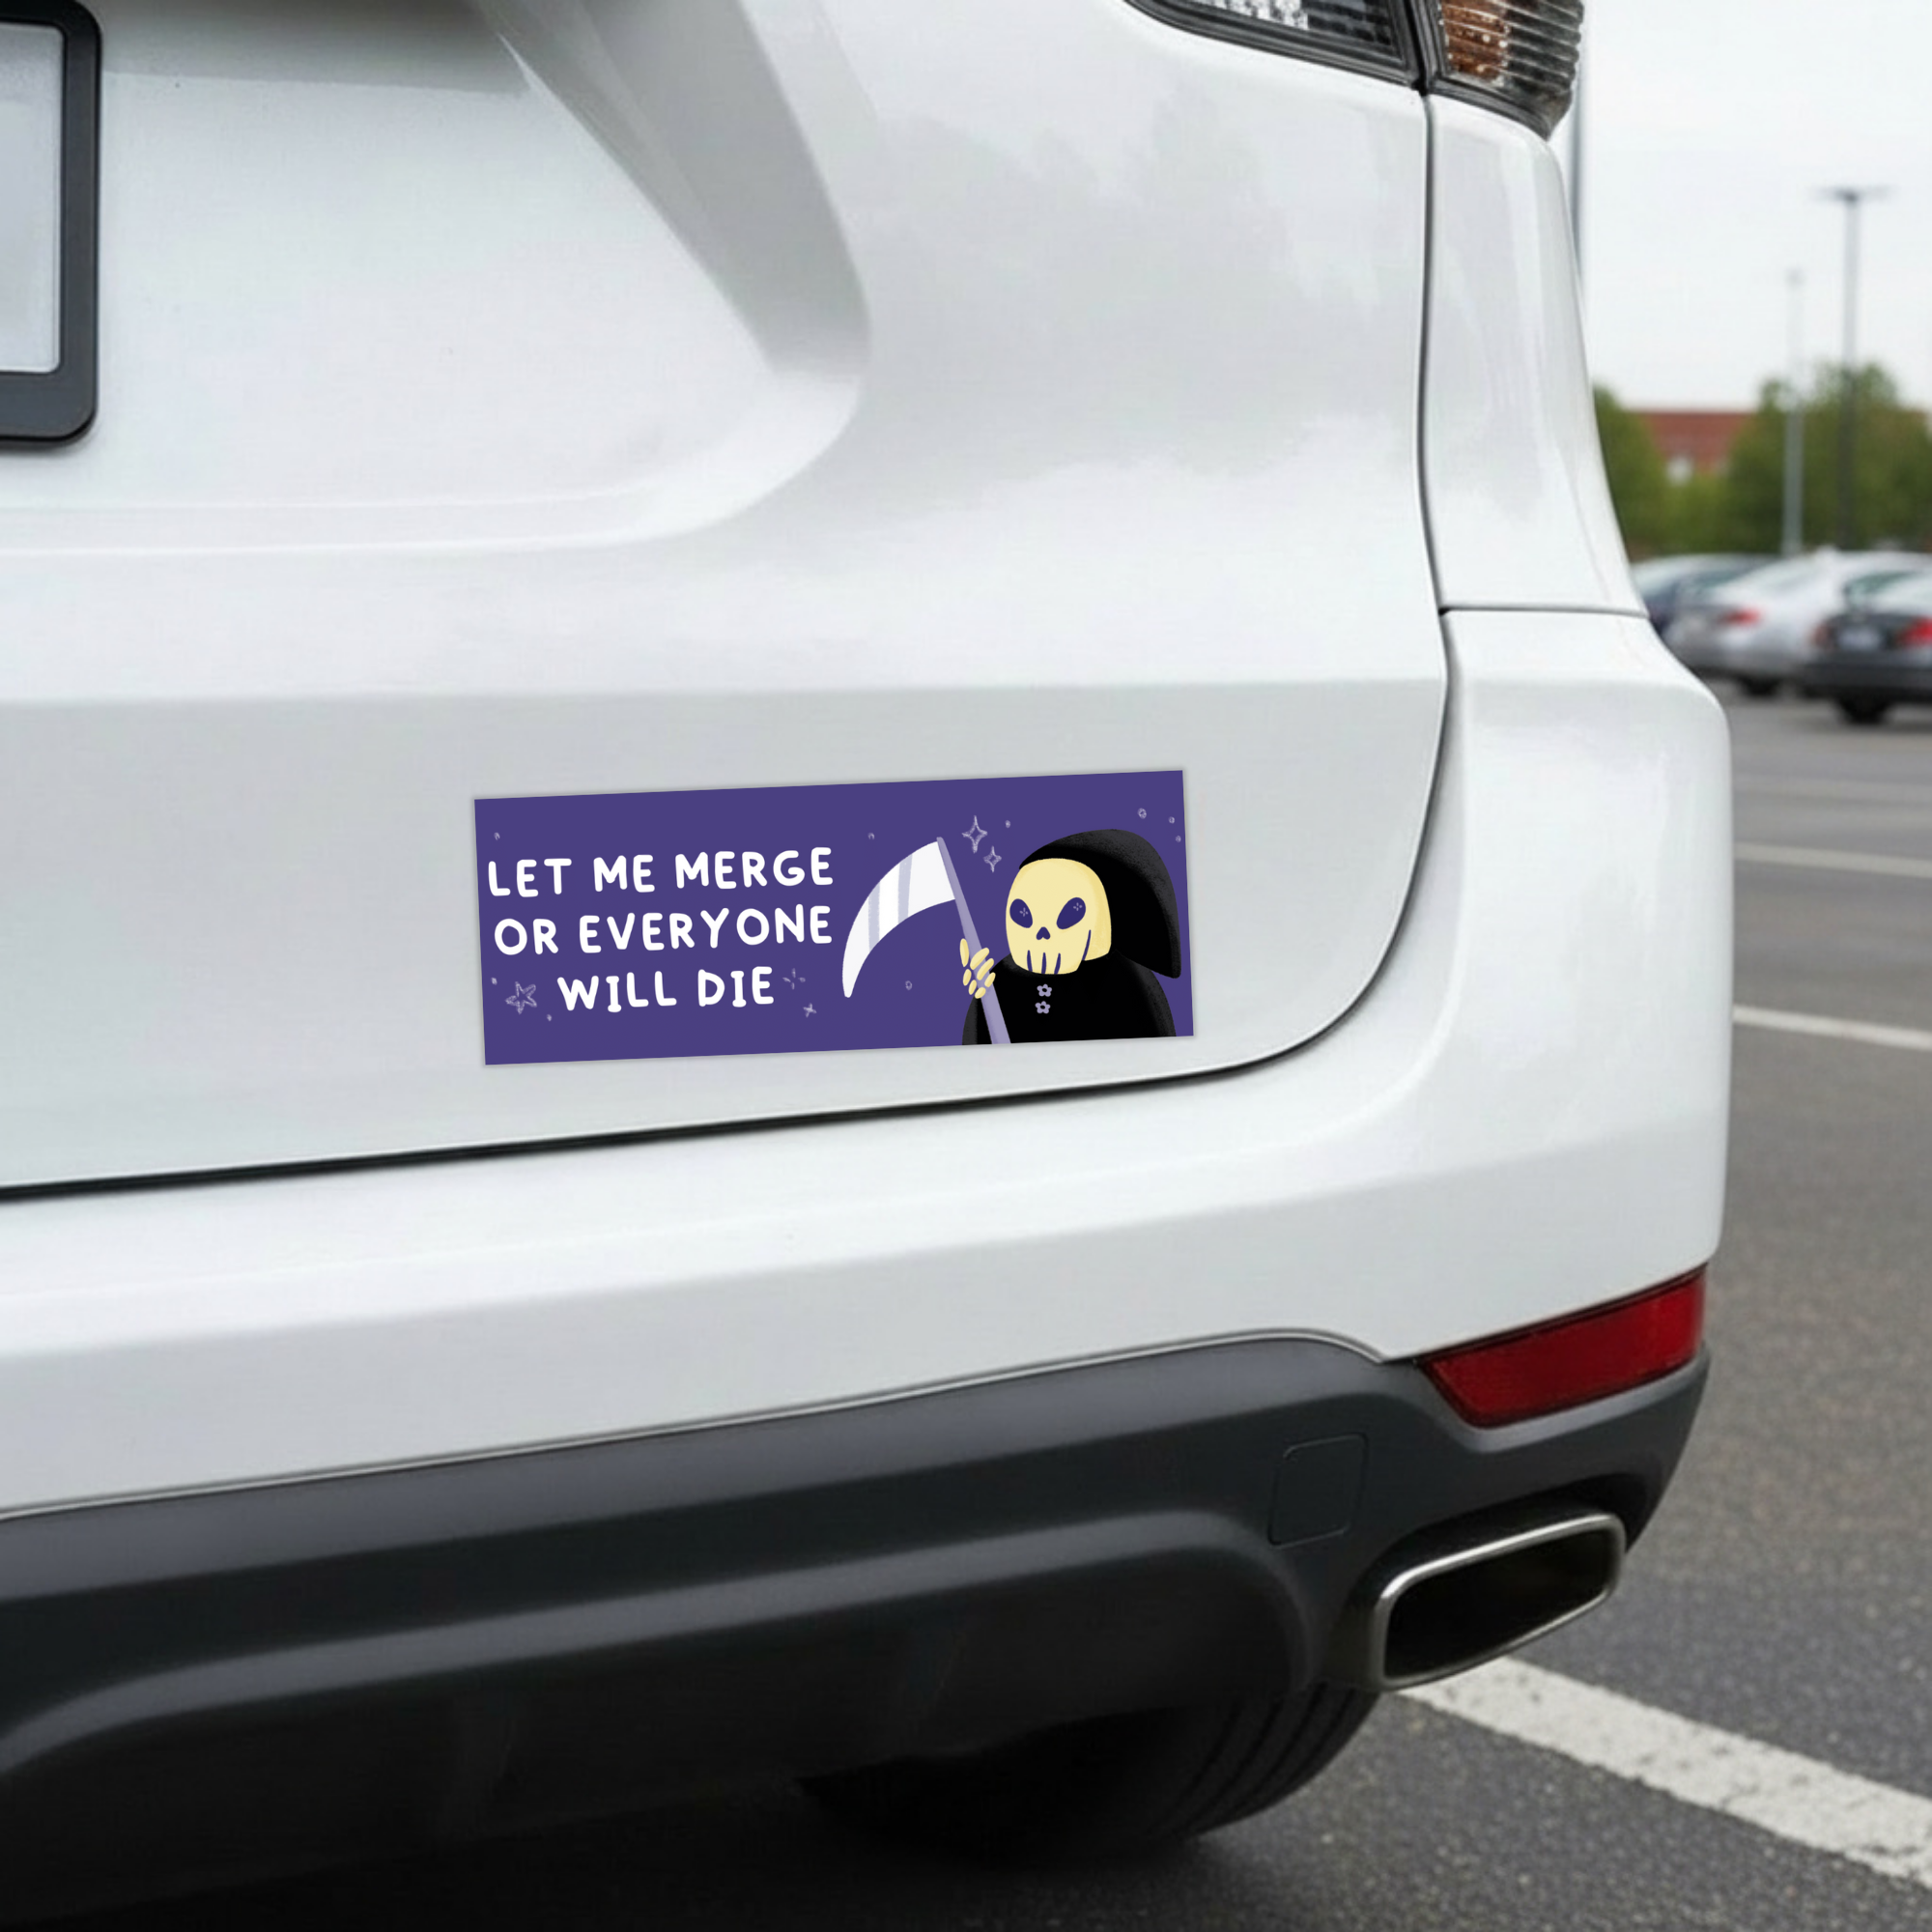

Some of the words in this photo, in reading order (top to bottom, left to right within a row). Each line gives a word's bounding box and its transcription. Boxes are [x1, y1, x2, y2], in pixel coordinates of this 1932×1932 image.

[488, 859, 572, 897] LET
[593, 854, 655, 893] ME
[675, 847, 834, 889] MERGE
[494, 918, 558, 955] OR
[579, 903, 833, 953] EVERYONE
[556, 971, 678, 1013] WILL
[697, 966, 774, 1008] DIE
